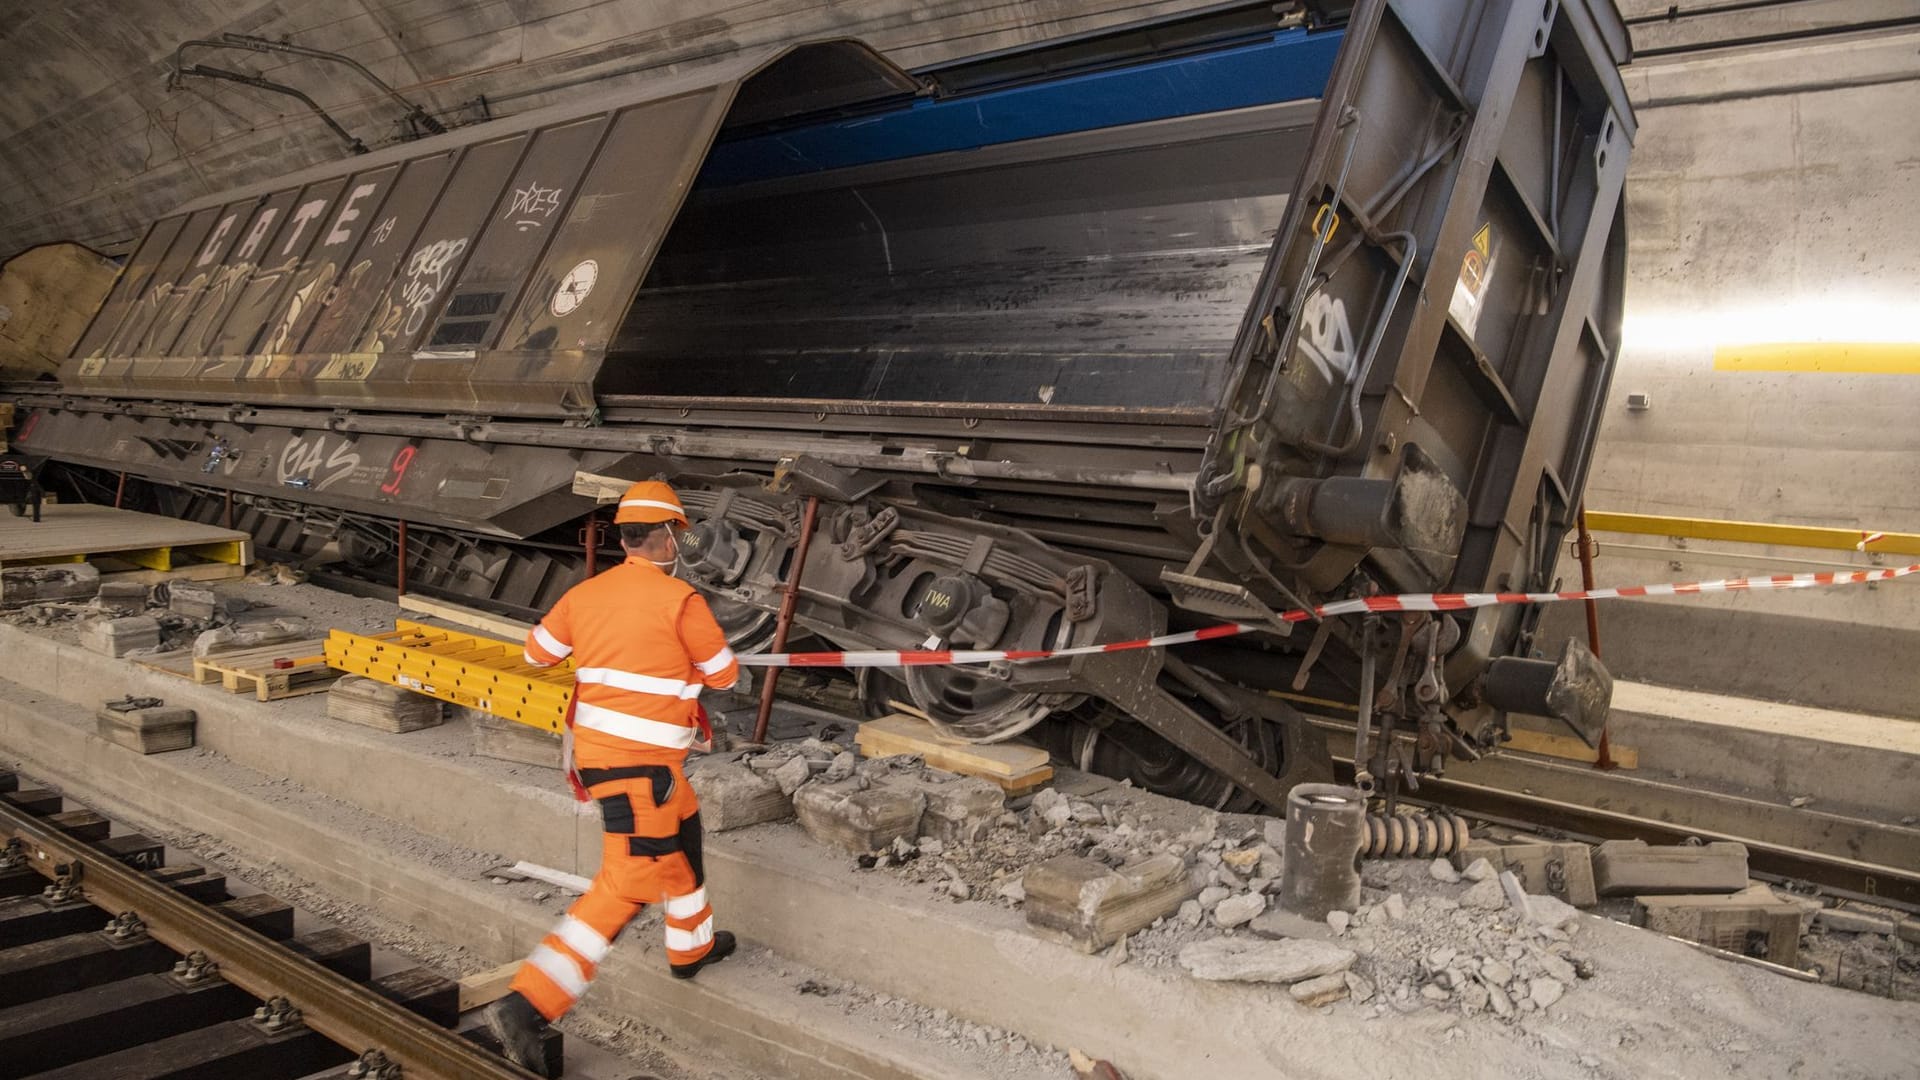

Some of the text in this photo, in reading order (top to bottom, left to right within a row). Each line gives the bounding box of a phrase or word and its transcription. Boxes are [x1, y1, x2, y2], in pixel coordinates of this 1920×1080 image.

[373, 215, 398, 248] 19
[682, 531, 700, 548] TWA
[925, 589, 950, 608] TWA
